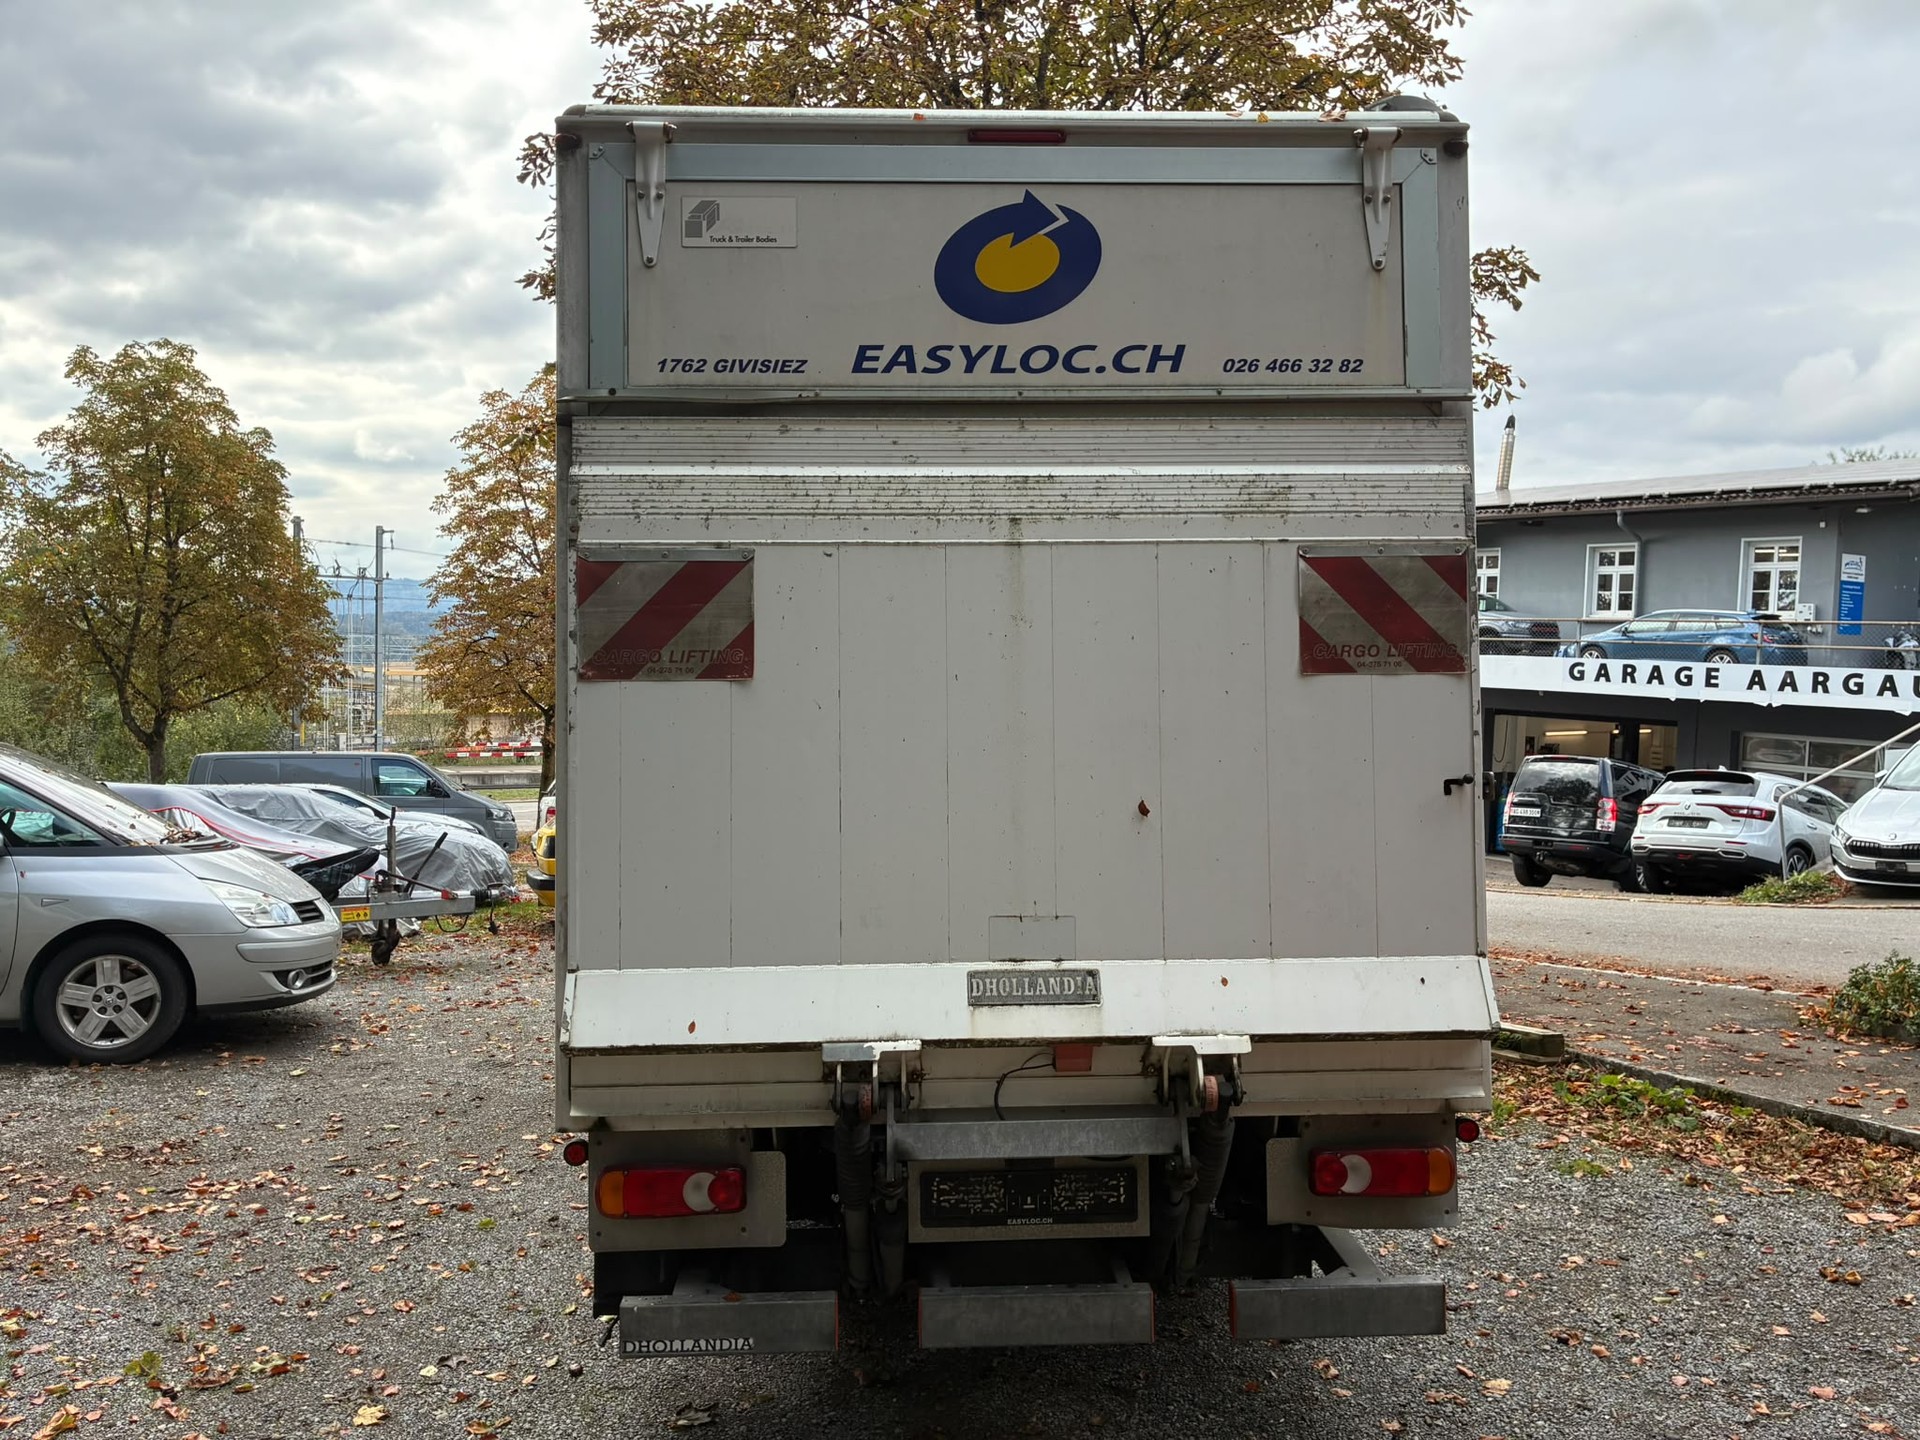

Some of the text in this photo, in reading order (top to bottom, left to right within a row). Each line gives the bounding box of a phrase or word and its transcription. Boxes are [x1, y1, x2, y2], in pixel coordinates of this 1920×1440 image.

[709, 235, 778, 243] Truck & Trailer Bodies
[657, 358, 808, 374] 1762 GIVISIEZ
[850, 344, 1186, 374] EASYLOC.CH
[1222, 358, 1364, 373] 026 466 32 82
[592, 648, 745, 665] CARGO LIFTING
[1313, 642, 1459, 659] CARGO LIFTING
[1568, 661, 1720, 689] GARAGE
[971, 976, 1099, 997] DHOLLANDIA
[1007, 1217, 1053, 1225] EASYLOC.CH
[622, 1338, 753, 1354] DHOLLANDIA
